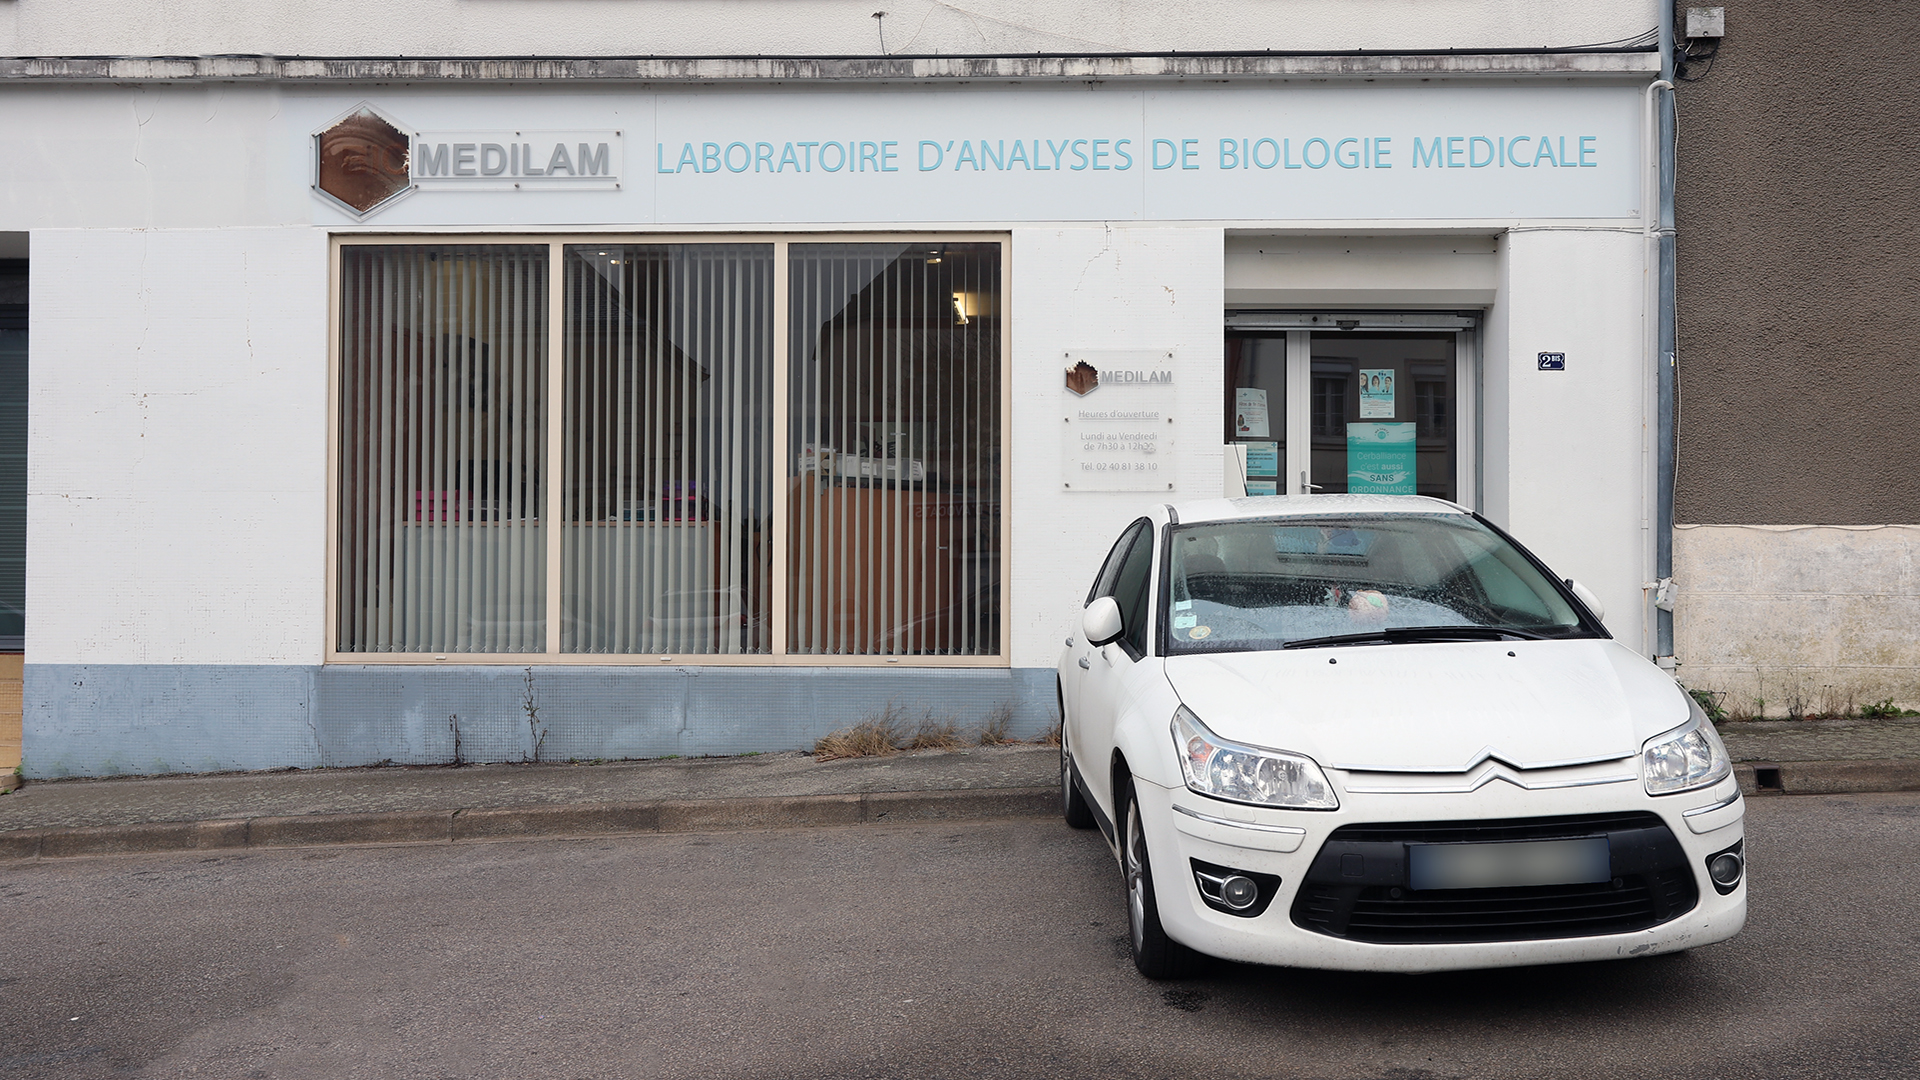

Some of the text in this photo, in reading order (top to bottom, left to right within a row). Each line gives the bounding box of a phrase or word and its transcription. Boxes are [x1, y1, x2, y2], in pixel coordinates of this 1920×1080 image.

[418, 143, 609, 175] MEDILAM
[657, 141, 899, 174] LABORATOIRE
[1152, 138, 1200, 170] DE
[1219, 137, 1392, 170] BIOLOGIE
[1412, 136, 1598, 168] MEDICALE
[1542, 355, 1551, 367] 2
[1101, 371, 1172, 383] MEDILAM
[1078, 410, 1108, 418] Heures
[1080, 432, 1158, 441] Lundi au Vendredi
[1084, 442, 1095, 450] de
[1097, 442, 1119, 451] 7h30
[1357, 452, 1406, 460] Cerballiance
[1096, 462, 1107, 471] 02
[1108, 462, 1120, 471] 40
[1121, 462, 1132, 471] 81
[1134, 462, 1145, 471] 38
[1148, 462, 1158, 471] 10
[1381, 462, 1404, 471] aussi
[1369, 474, 1395, 482] SANS
[1351, 485, 1414, 494] ORDONNANCE
